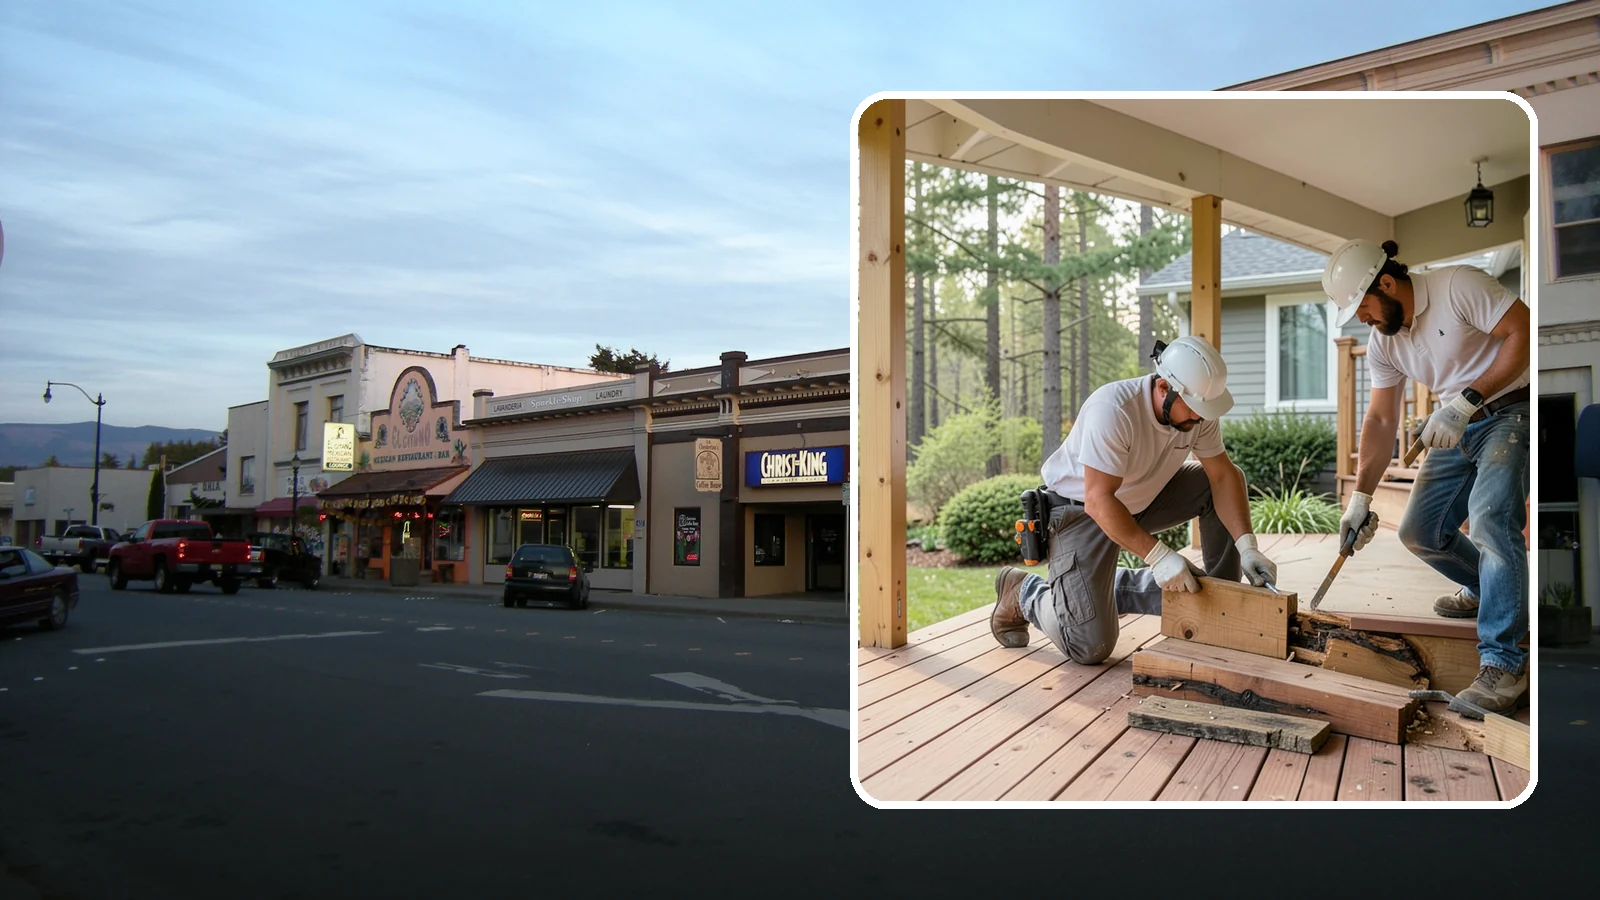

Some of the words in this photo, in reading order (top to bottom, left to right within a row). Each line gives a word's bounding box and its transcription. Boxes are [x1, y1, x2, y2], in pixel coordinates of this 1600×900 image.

[595, 389, 623, 400] LAUNDRY
[493, 402, 522, 412] LAVANDERIA
[530, 397, 560, 409] Sparkle
[561, 394, 582, 405] Shop
[397, 451, 433, 462] RESTAURANT
[438, 450, 450, 459] BAR
[761, 452, 797, 478] CHRIST
[799, 450, 827, 476] KING
